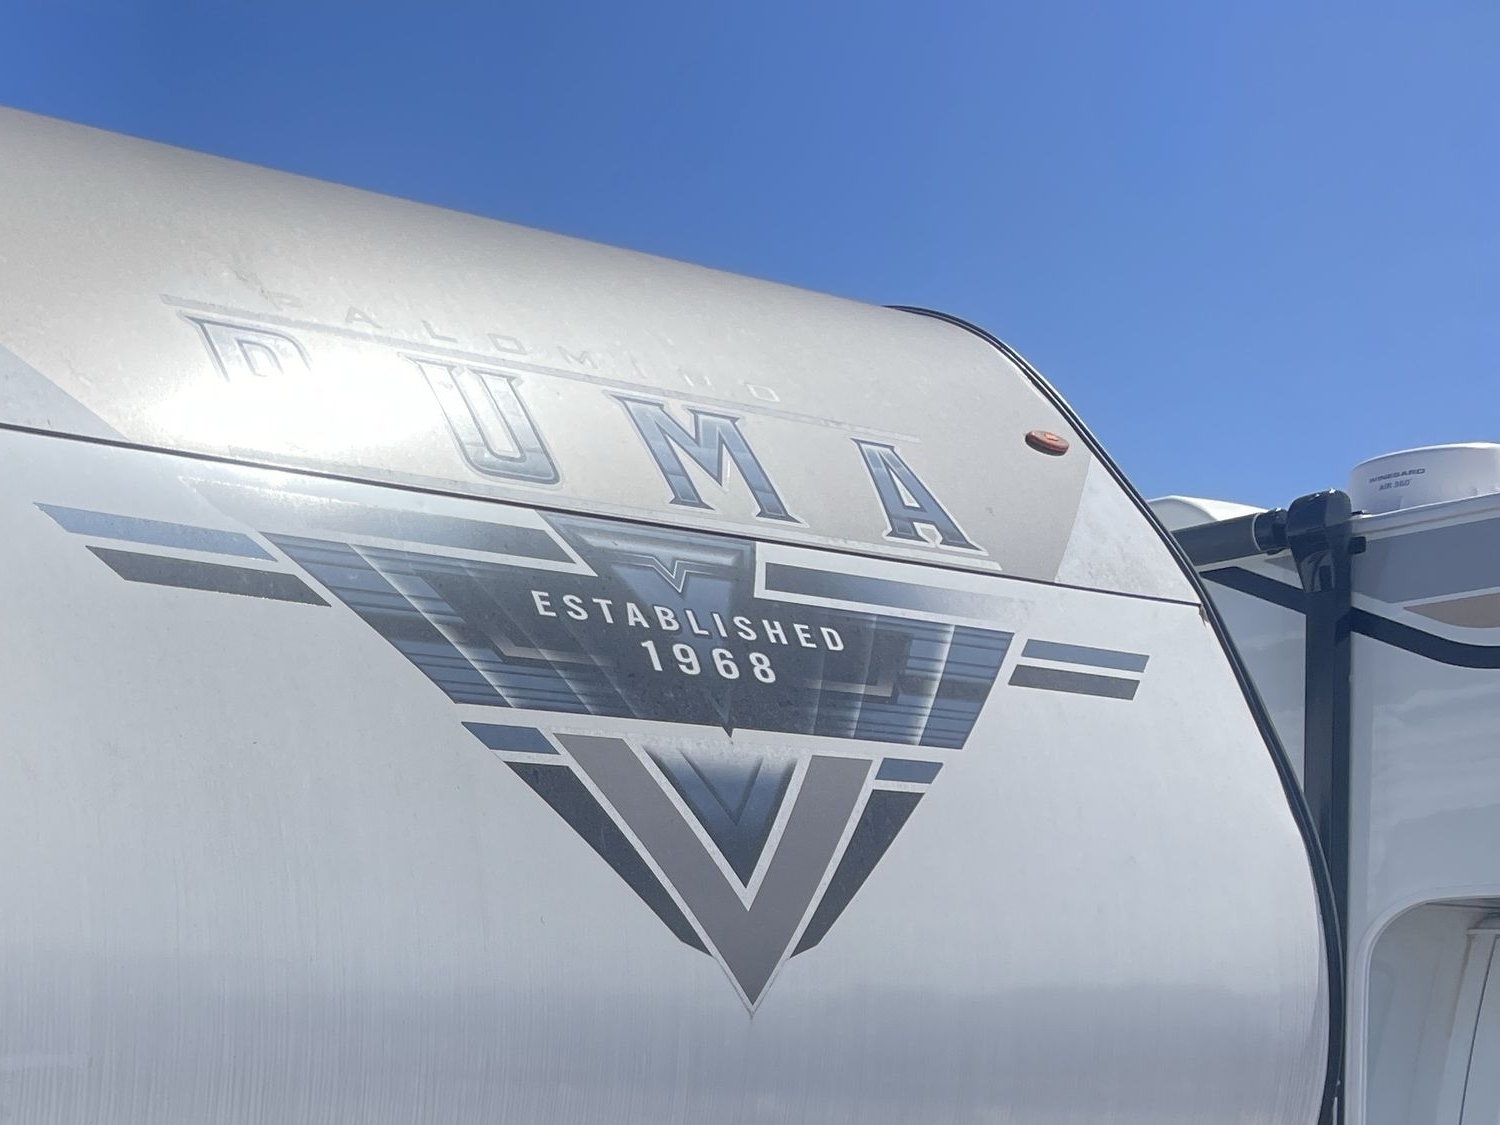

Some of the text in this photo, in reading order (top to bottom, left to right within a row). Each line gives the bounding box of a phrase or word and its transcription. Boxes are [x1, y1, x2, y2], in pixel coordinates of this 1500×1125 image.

[1368, 467, 1426, 483] WINEGARD
[530, 589, 846, 653] ESTABLISHED
[640, 640, 777, 685] 1968
